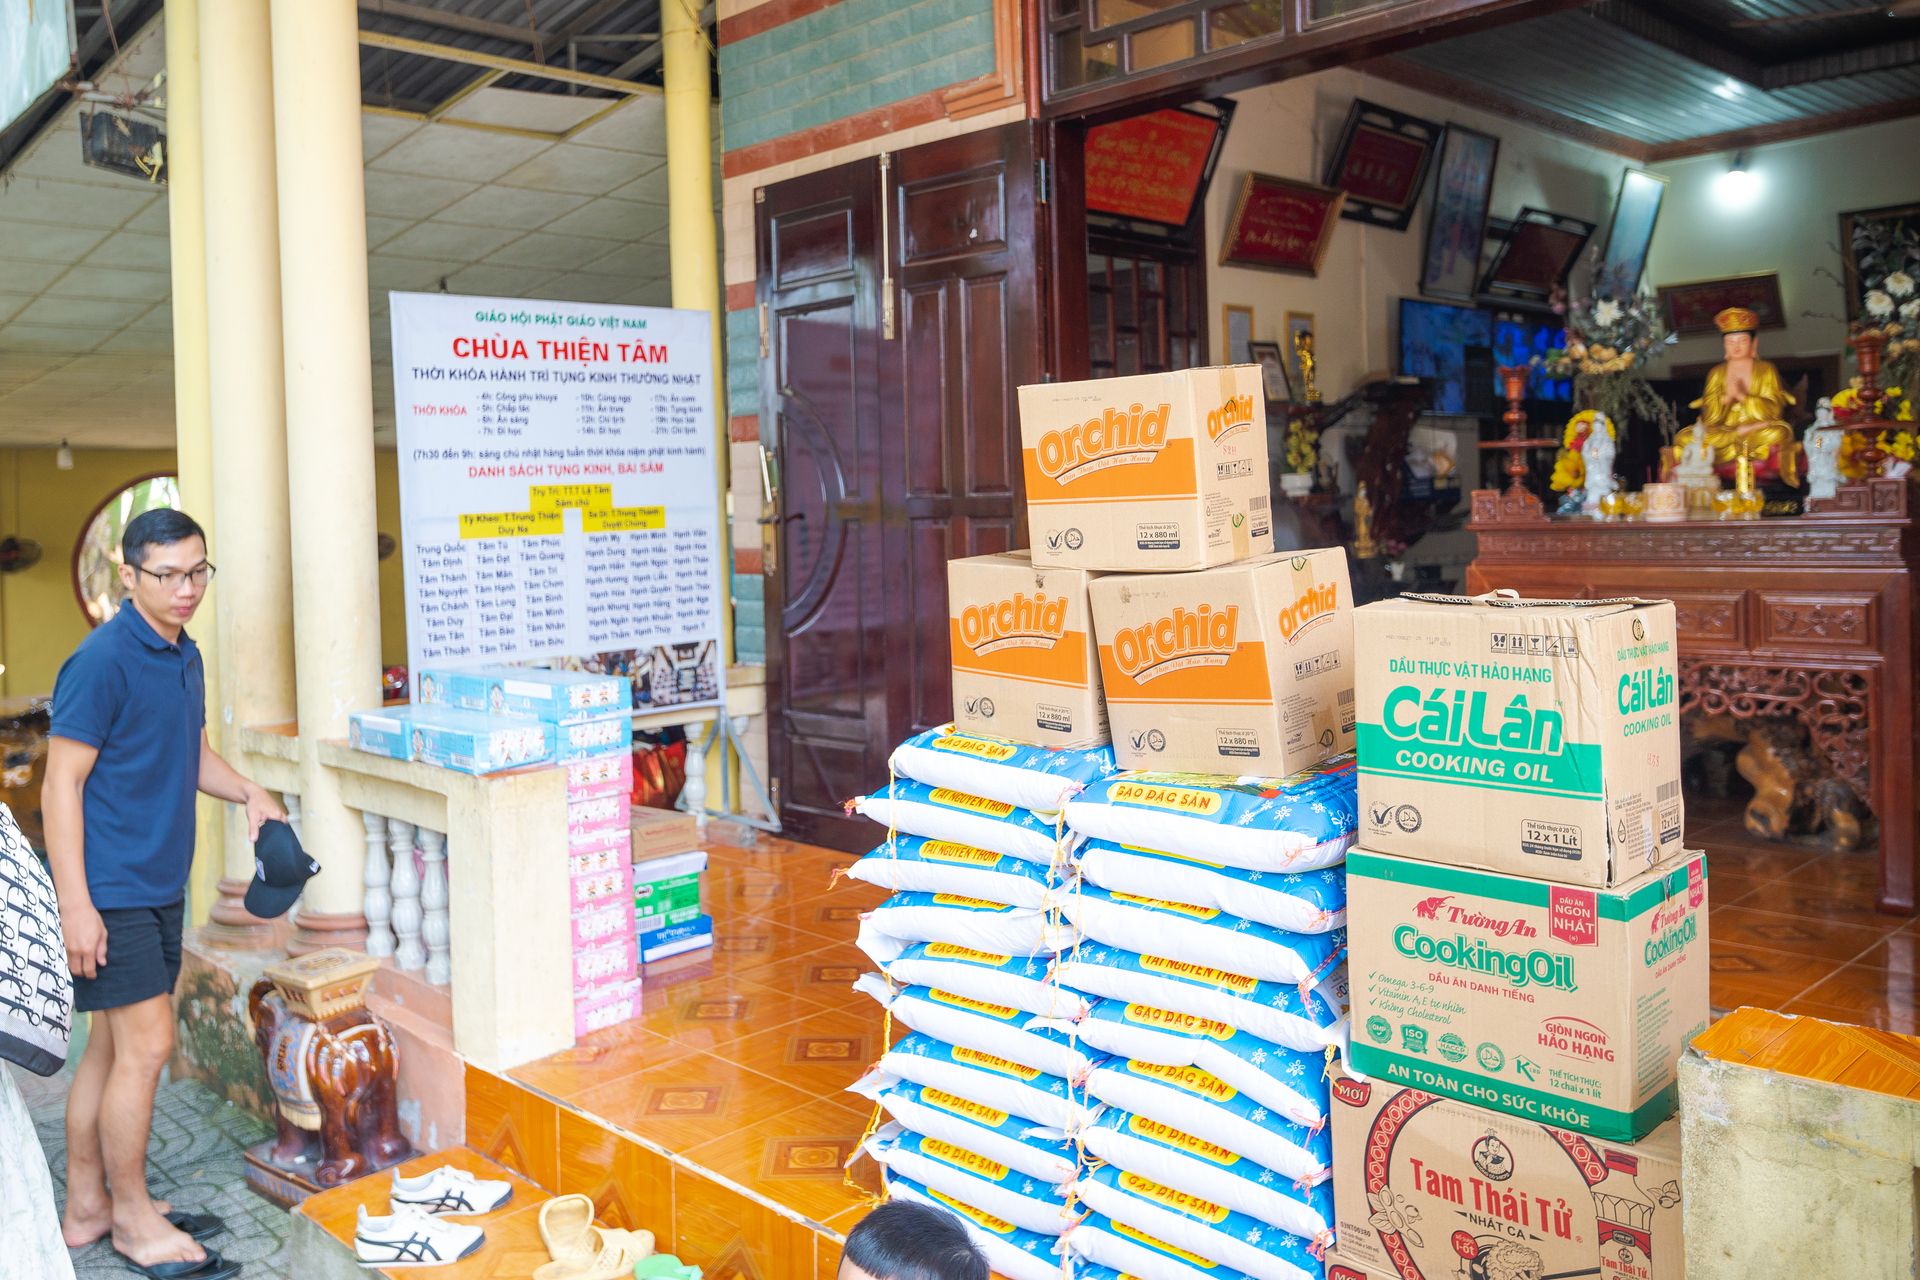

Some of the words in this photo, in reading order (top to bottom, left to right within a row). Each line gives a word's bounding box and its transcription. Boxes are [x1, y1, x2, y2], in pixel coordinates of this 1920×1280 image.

[475, 309, 507, 323] GIÁO
[510, 310, 531, 327] HỘI
[566, 314, 596, 328] GIÁO
[600, 316, 620, 330] VIỆT
[623, 319, 648, 329] NAM
[452, 332, 529, 359] CHÙA
[536, 336, 609, 368] THIỆN
[616, 339, 668, 364] TÂM
[589, 372, 618, 384] KINH
[468, 464, 506, 478] DANH
[508, 463, 544, 477] SÁCH
[1139, 531, 1148, 539] 12
[1154, 531, 1168, 539] 880
[1168, 530, 1178, 538] ml
[1389, 655, 1415, 674] DẦU
[1418, 660, 1451, 679] THỰC
[1453, 661, 1479, 680] VẬT
[1481, 661, 1510, 681] HẢO
[1512, 666, 1552, 684] HẠNG
[1039, 711, 1046, 719] 12
[1051, 713, 1062, 722] 880
[1062, 714, 1071, 722] ml
[1623, 714, 1660, 737] COOKING
[1660, 712, 1672, 726] OIL
[1219, 736, 1229, 744] 12
[1234, 737, 1247, 745] 880
[1247, 736, 1257, 745] ml
[1395, 749, 1506, 778] COOKING
[1513, 761, 1554, 783] OIL
[1527, 830, 1541, 841] 12
[1543, 834, 1550, 842] x
[1553, 834, 1558, 843] 1
[1562, 834, 1578, 846] Lít
[1555, 904, 1591, 918] NGON
[1409, 980, 1435, 993] 3-6-9
[1470, 981, 1499, 996] DANH
[1503, 987, 1535, 1003] TIẾNG
[1378, 987, 1411, 1002] Vitamin
[1407, 1006, 1452, 1025] Cholesterol
[1404, 1028, 1424, 1040] ISO
[1545, 1022, 1573, 1037] GIÒN
[1574, 1029, 1606, 1046] NGON
[1440, 1041, 1466, 1053] HACCP
[1537, 1032, 1569, 1051] HẢO
[1572, 1041, 1615, 1063] HẠNG
[1340, 1085, 1364, 1100] MỚI
[1550, 1078, 1559, 1088] 12
[1561, 1081, 1578, 1092] chai
[1387, 1063, 1410, 1080] AN
[1412, 1069, 1459, 1093] TOÀN
[1462, 1083, 1499, 1101] CHO
[1502, 1094, 1537, 1114] SỨC
[1541, 1103, 1590, 1128] KHỎE
[1410, 1157, 1464, 1206] Tam
[1469, 1176, 1529, 1227] Thái
[1535, 1197, 1573, 1241] Tử
[1507, 1225, 1526, 1241] CA
[1600, 1255, 1618, 1270] Tam
